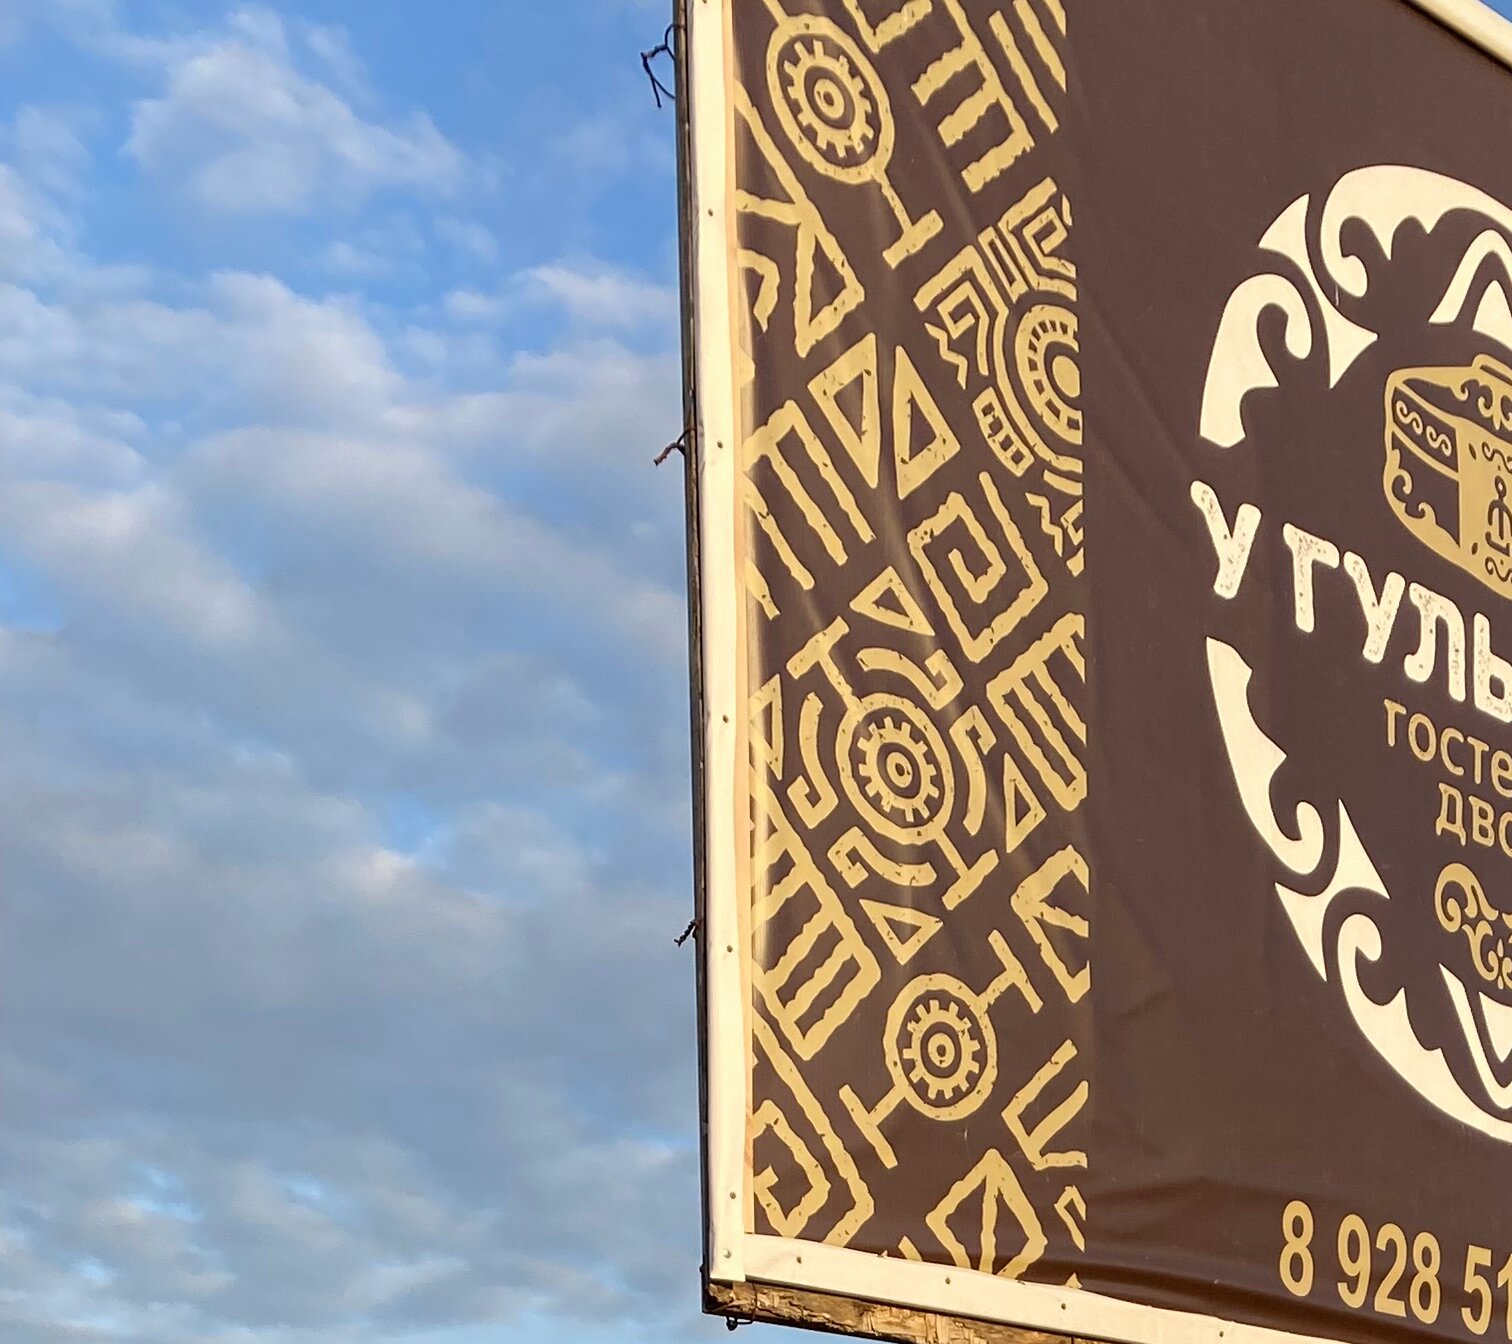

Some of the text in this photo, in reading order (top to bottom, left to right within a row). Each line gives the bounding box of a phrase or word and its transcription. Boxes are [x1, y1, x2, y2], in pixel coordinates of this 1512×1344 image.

[1190, 480, 1262, 599] У
[1279, 1200, 1314, 1297] 8
[1336, 1213, 1441, 1325] 928
